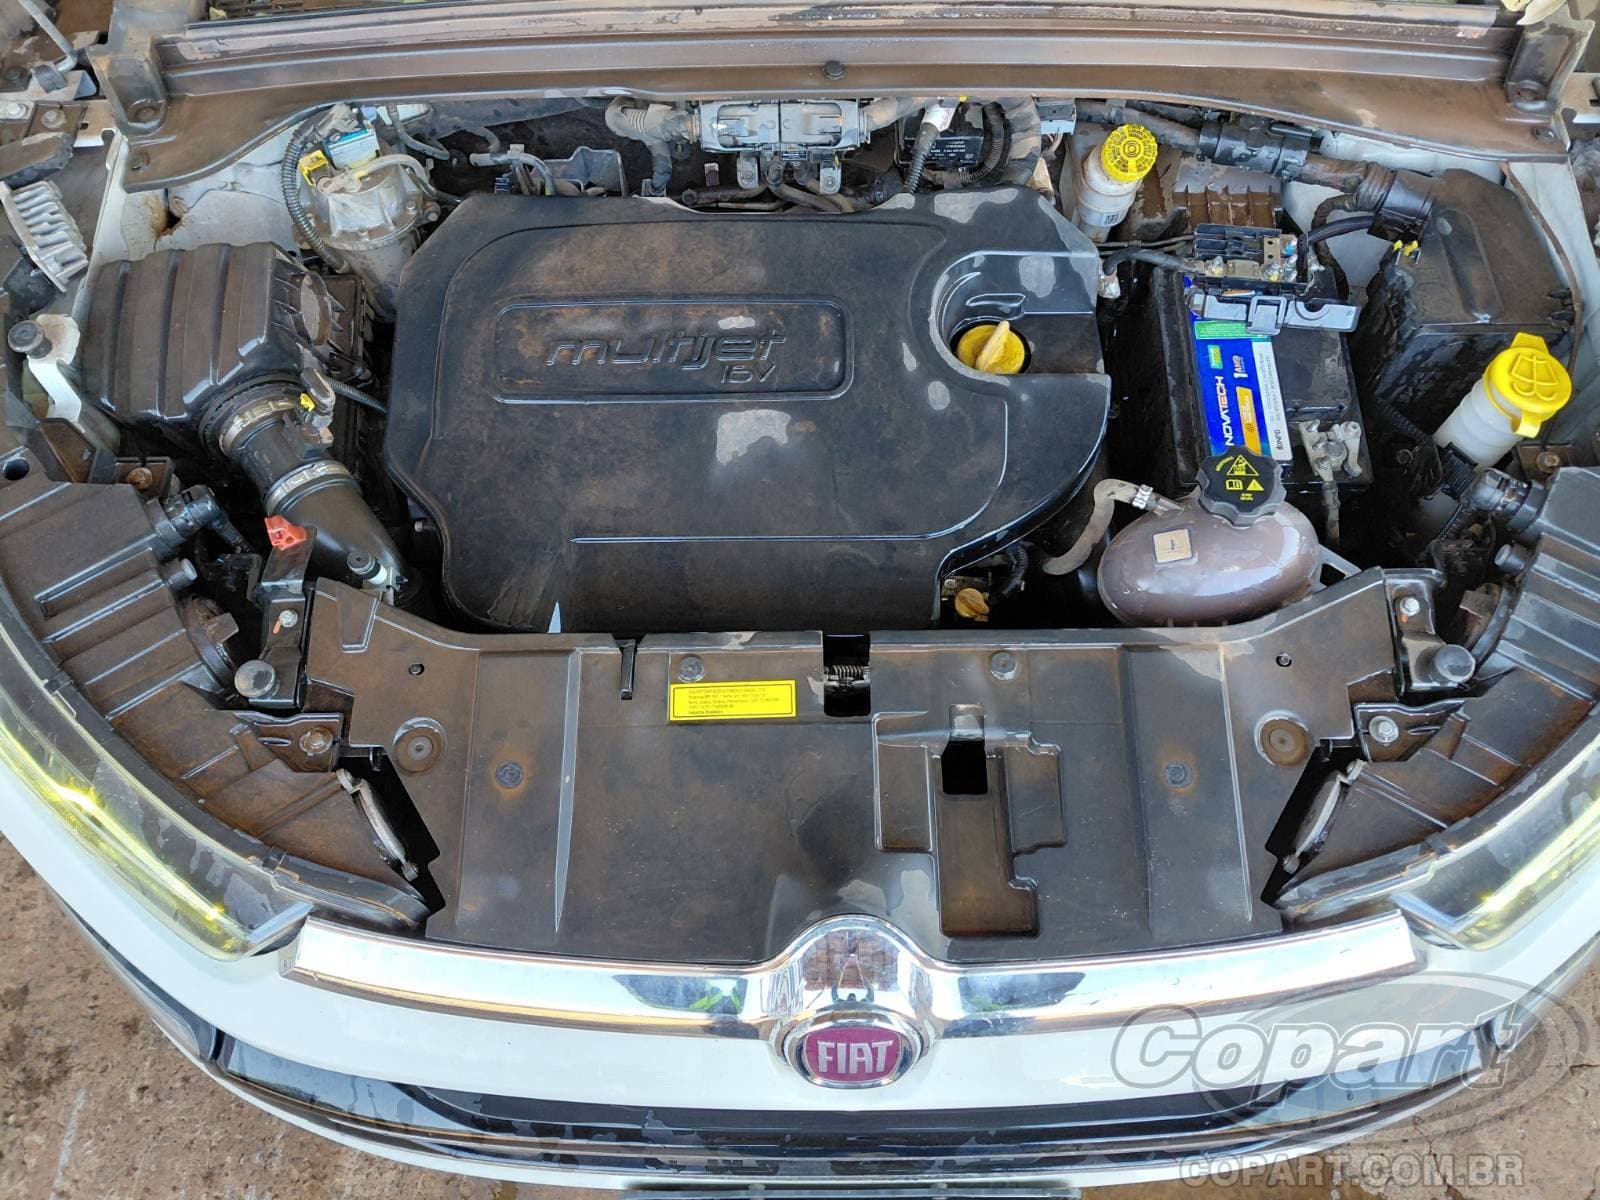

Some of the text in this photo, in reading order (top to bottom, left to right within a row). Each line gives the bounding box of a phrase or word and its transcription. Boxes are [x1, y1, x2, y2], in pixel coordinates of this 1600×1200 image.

[546, 329, 787, 370] multijet
[1215, 375, 1234, 447] NOVATECH
[816, 1039, 895, 1074] FIAT
